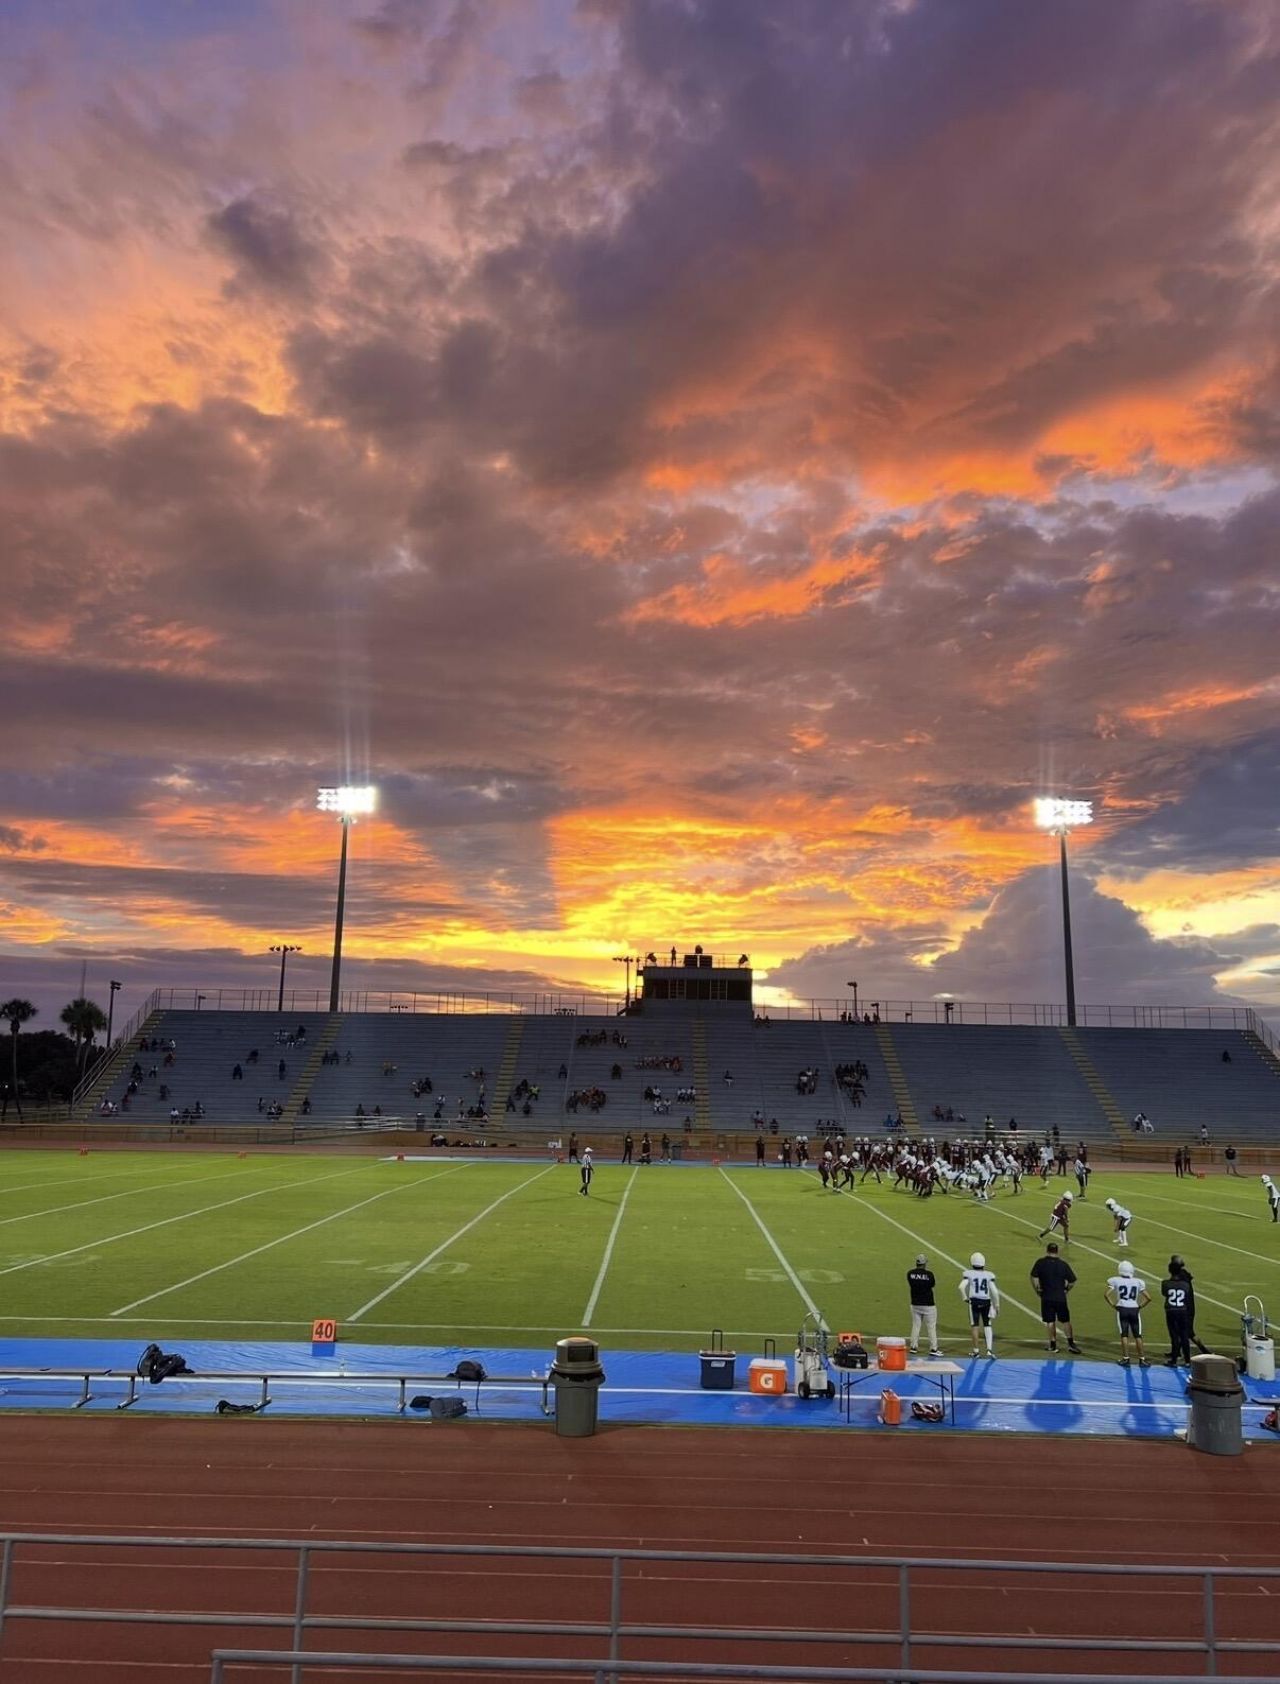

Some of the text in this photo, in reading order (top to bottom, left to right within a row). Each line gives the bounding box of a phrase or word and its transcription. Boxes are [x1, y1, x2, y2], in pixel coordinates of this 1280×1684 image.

[972, 1277, 989, 1295] 14
[1118, 1285, 1138, 1301] 24
[1167, 1288, 1186, 1307] 22
[314, 1322, 334, 1339] 40
[760, 1373, 774, 1389] G
